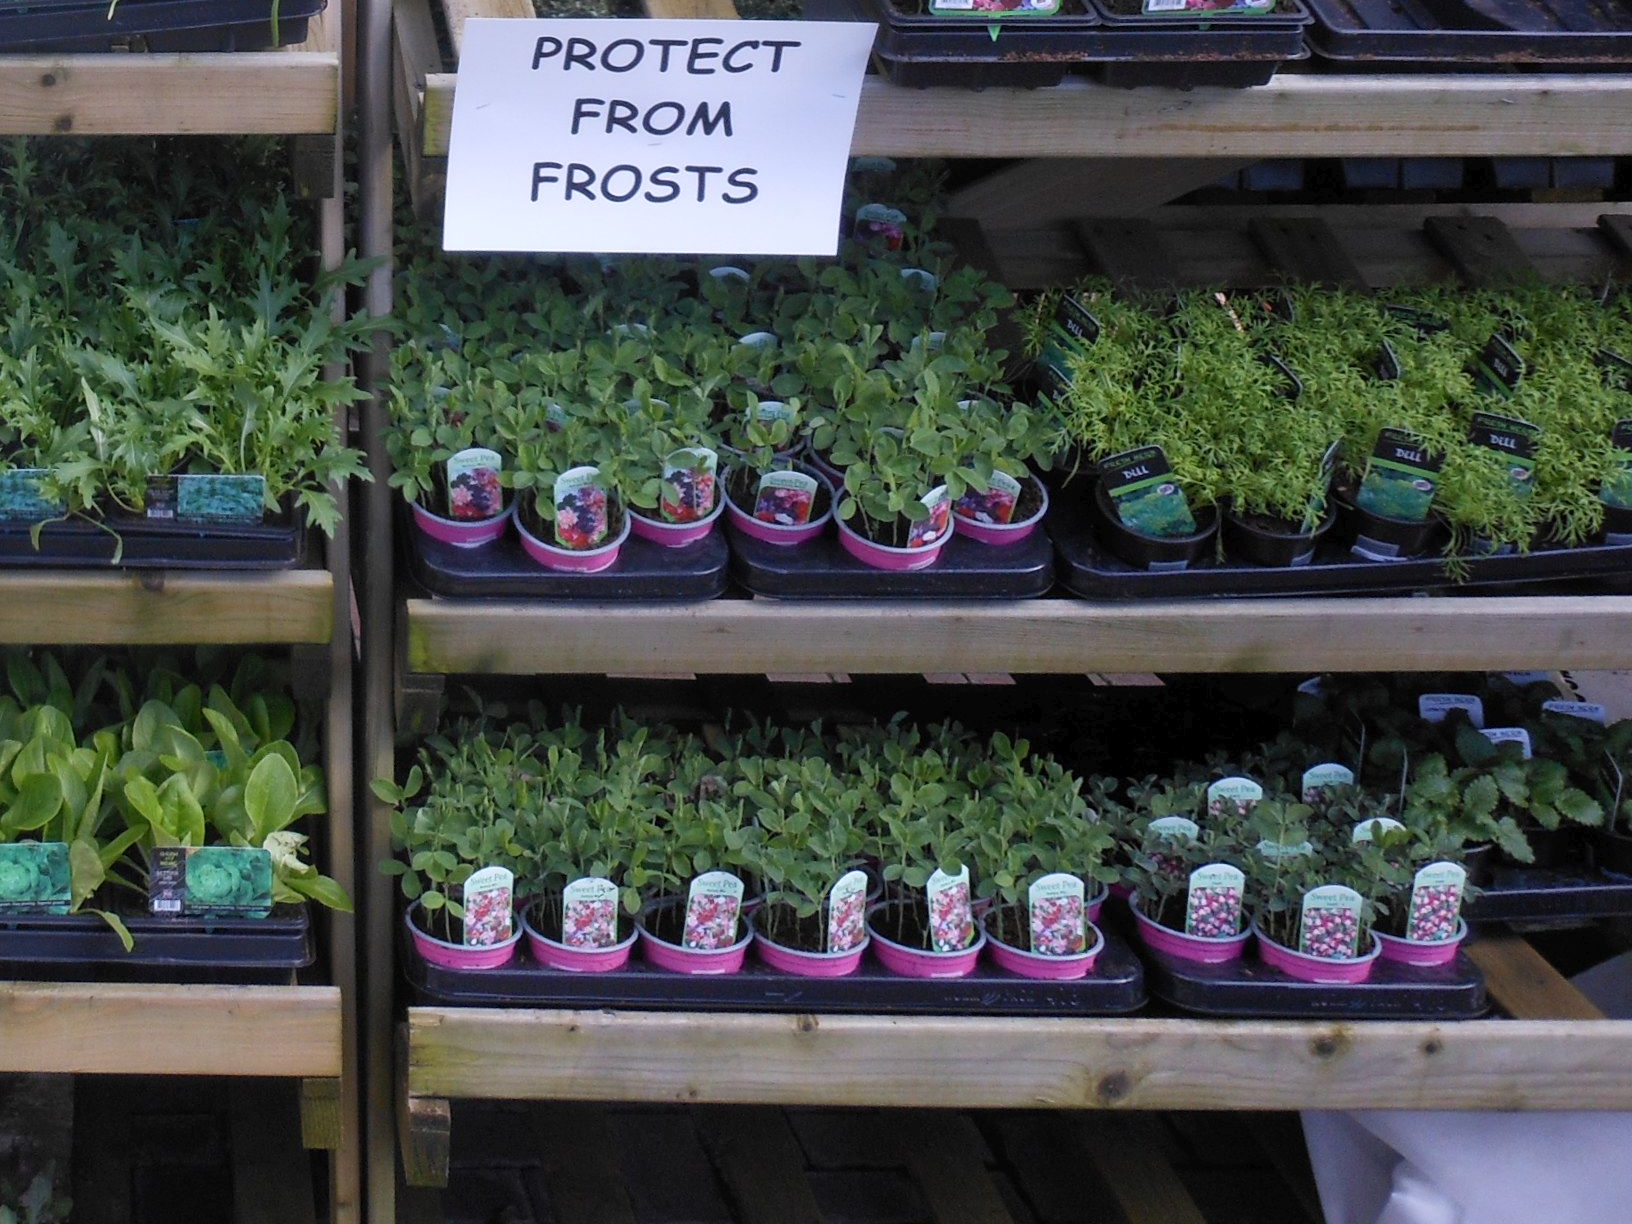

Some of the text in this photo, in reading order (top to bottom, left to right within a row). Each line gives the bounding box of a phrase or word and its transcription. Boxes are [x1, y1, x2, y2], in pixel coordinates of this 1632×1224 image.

[531, 36, 802, 75] PROTECT
[570, 97, 733, 137] FROM
[530, 162, 759, 205] FROSTS
[1489, 434, 1517, 449] Dill
[1395, 447, 1422, 462] Dill
[1122, 465, 1149, 479] Dill
[697, 879, 720, 887] Sweet
[1062, 880, 1077, 889] Pea
[1311, 893, 1354, 902] Sweet Pea
